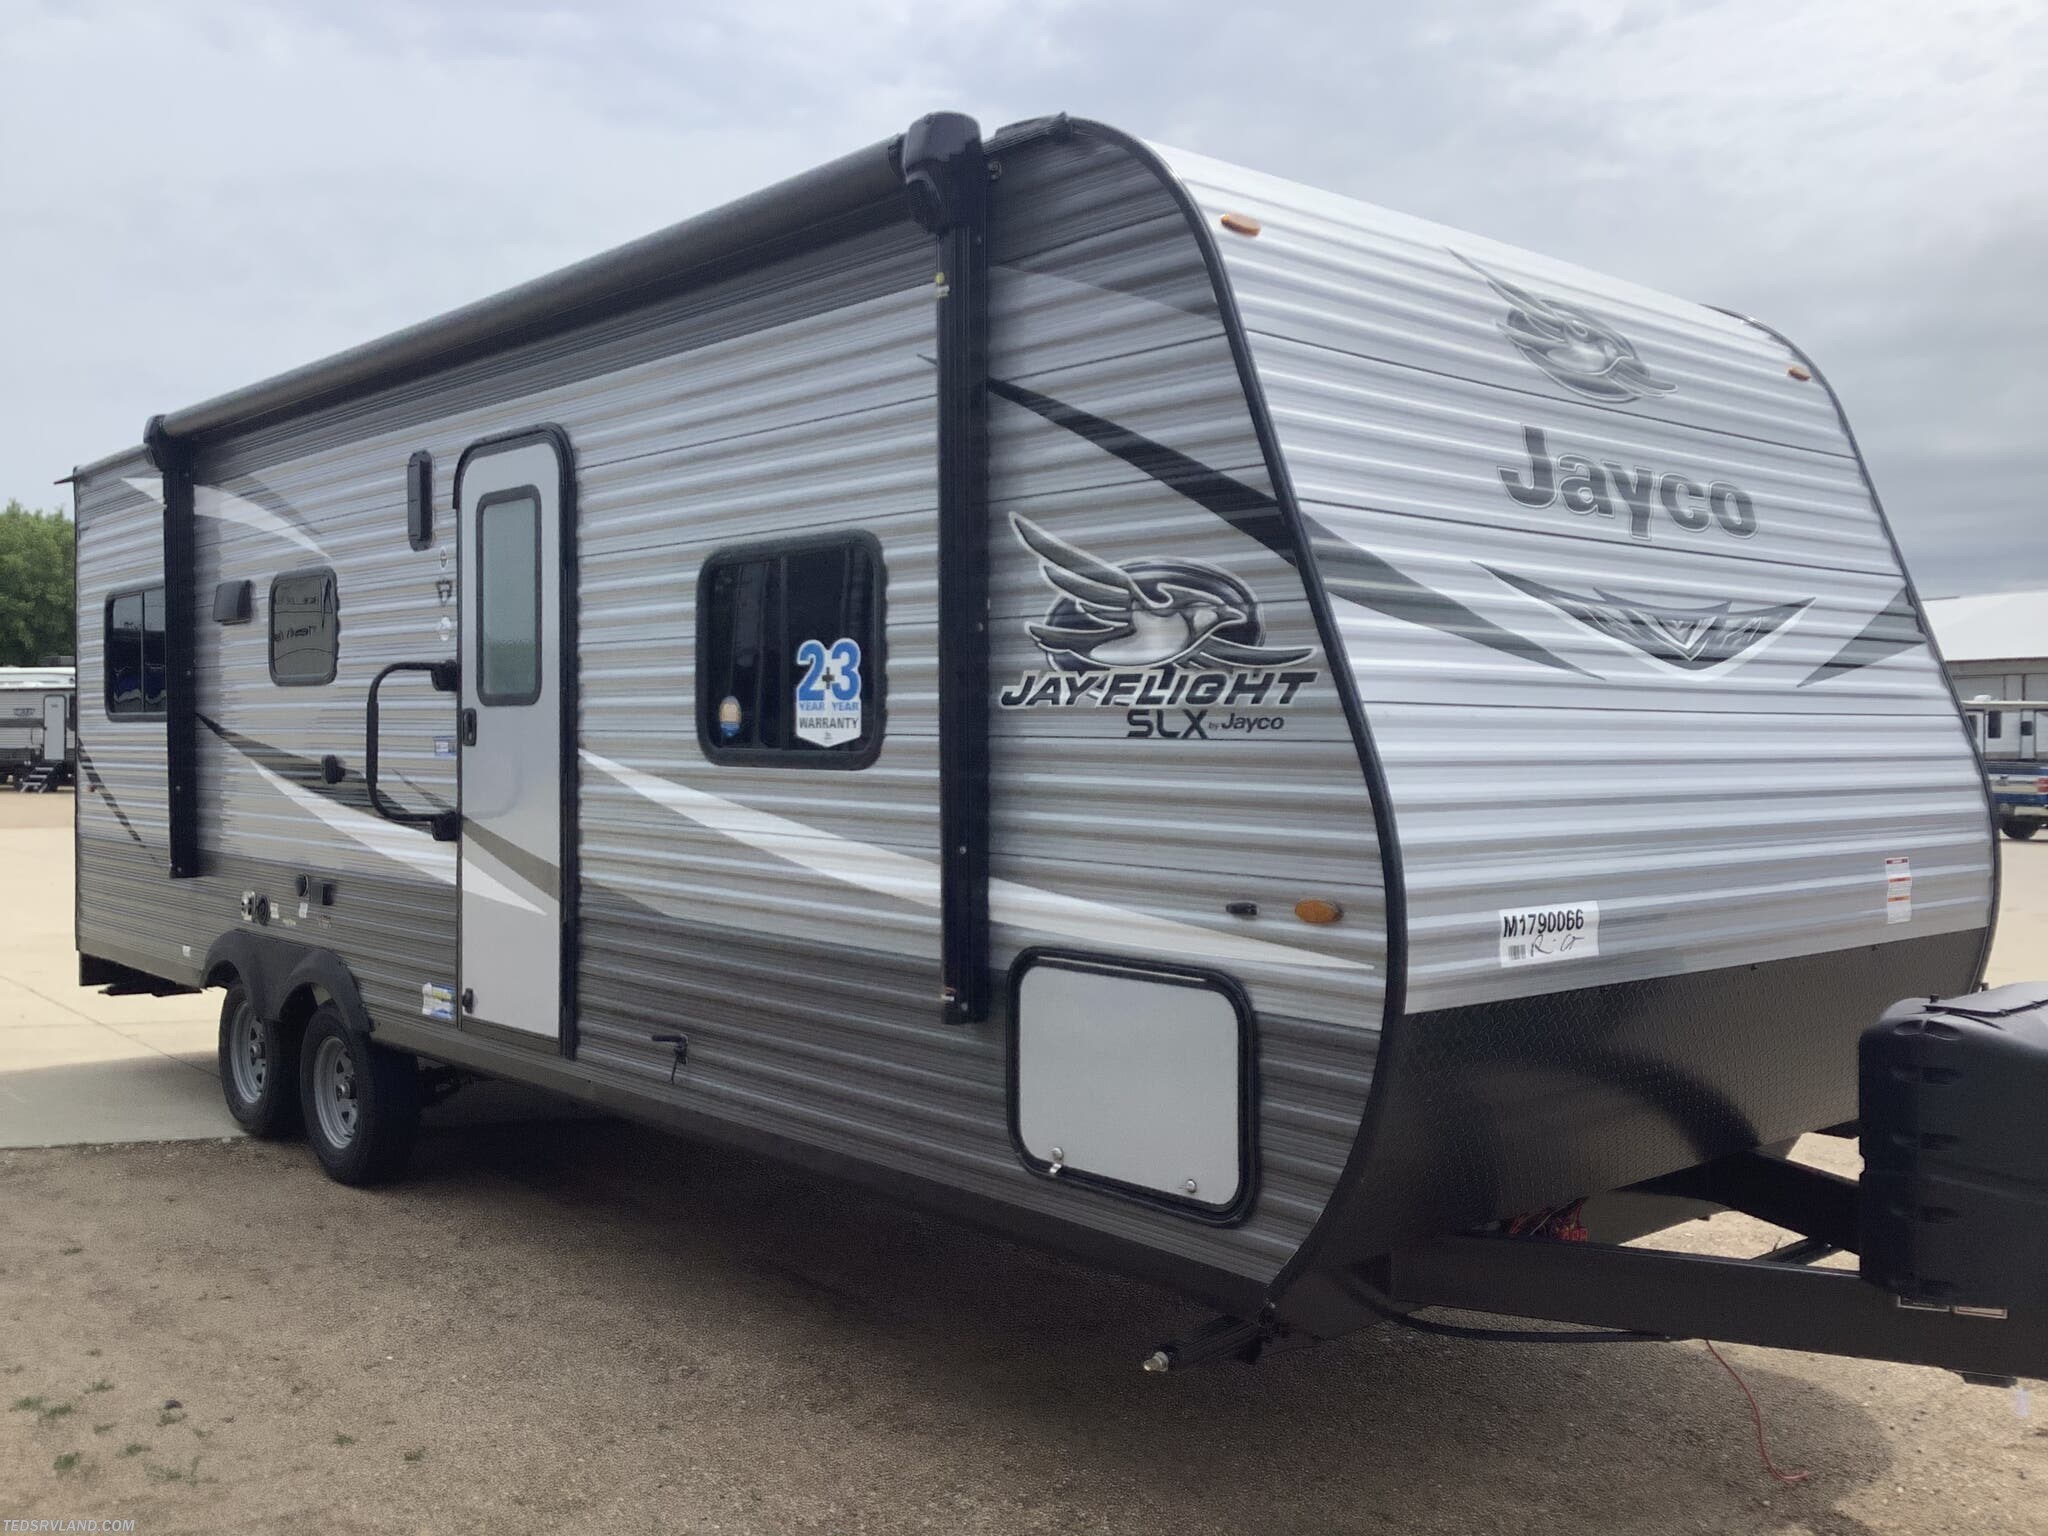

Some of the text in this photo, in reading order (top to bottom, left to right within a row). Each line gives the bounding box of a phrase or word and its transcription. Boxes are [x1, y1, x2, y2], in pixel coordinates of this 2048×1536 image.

[1495, 422, 1756, 540] Jayco
[799, 701, 859, 711] YEAR YEAR
[799, 717, 859, 729] WARRANTY
[1127, 708, 1209, 740] SLX
[1221, 713, 1285, 737] Jayco
[1503, 908, 1584, 938] M1790066
